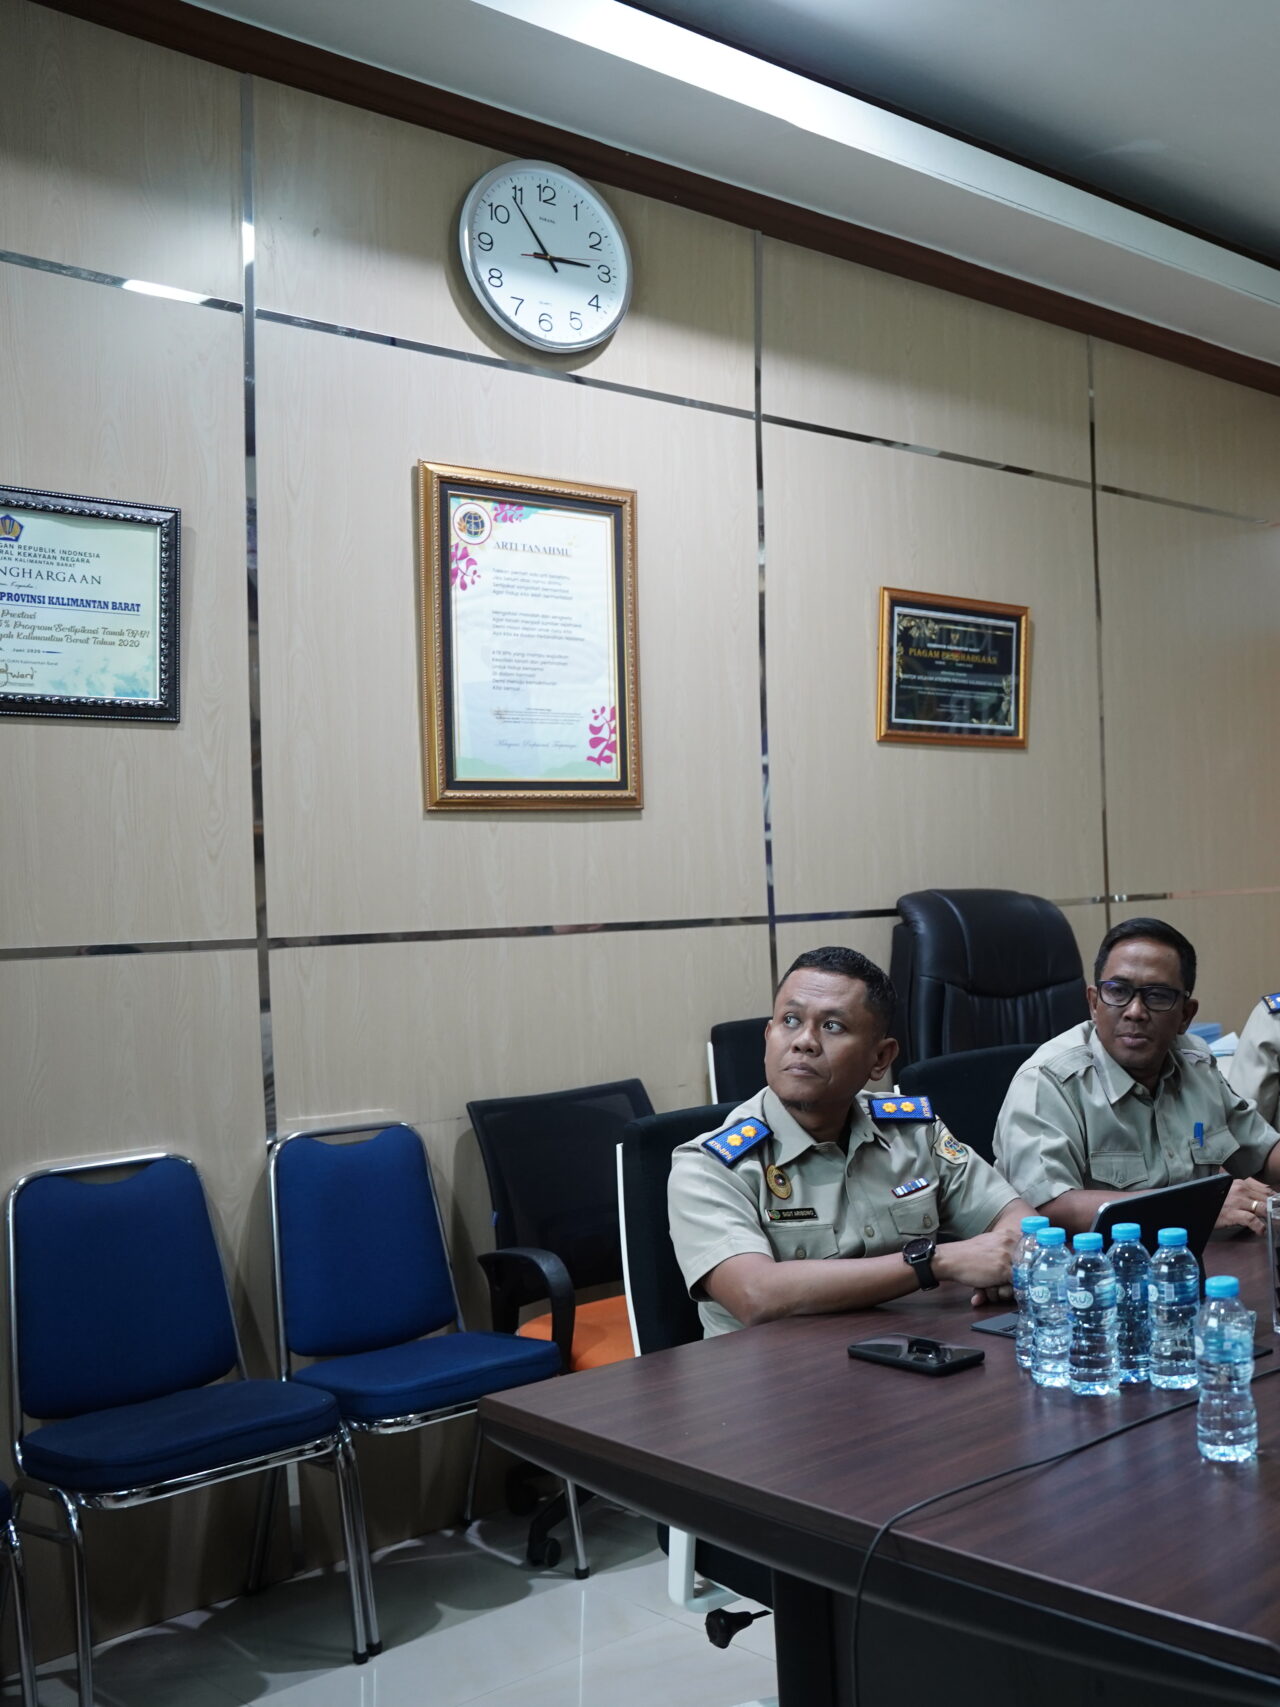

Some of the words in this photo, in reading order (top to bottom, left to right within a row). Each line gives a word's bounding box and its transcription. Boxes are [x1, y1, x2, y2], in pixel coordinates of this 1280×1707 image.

[512, 184, 524, 205] 11
[536, 183, 557, 206] 12
[488, 202, 510, 224] 10
[573, 203, 579, 221] 1
[477, 231, 494, 252] 9
[588, 231, 603, 251] 2
[488, 268, 504, 288] 8
[597, 264, 612, 284] 3
[510, 296, 525, 316] 7
[587, 294, 602, 312] 4
[538, 313, 553, 332] 6
[569, 311, 583, 331] 5
[15, 557, 54, 566] KALIMANTAN
[17, 544, 56, 554] REPUBLIK
[59, 549, 101, 559] INDONESIA
[17, 551, 57, 561] KEKAYAAN
[60, 555, 90, 564] NEGARA
[0, 565, 102, 585] NGHARGAAN
[0, 591, 45, 605] PROVINSI
[48, 595, 109, 610] KALIMANTAN
[111, 601, 141, 612] BARAT
[13, 620, 53, 636] Program
[16, 632, 63, 643] Kalimantan
[64, 634, 90, 645] Barat
[92, 636, 116, 646] Tahun
[118, 638, 140, 648] 2020
